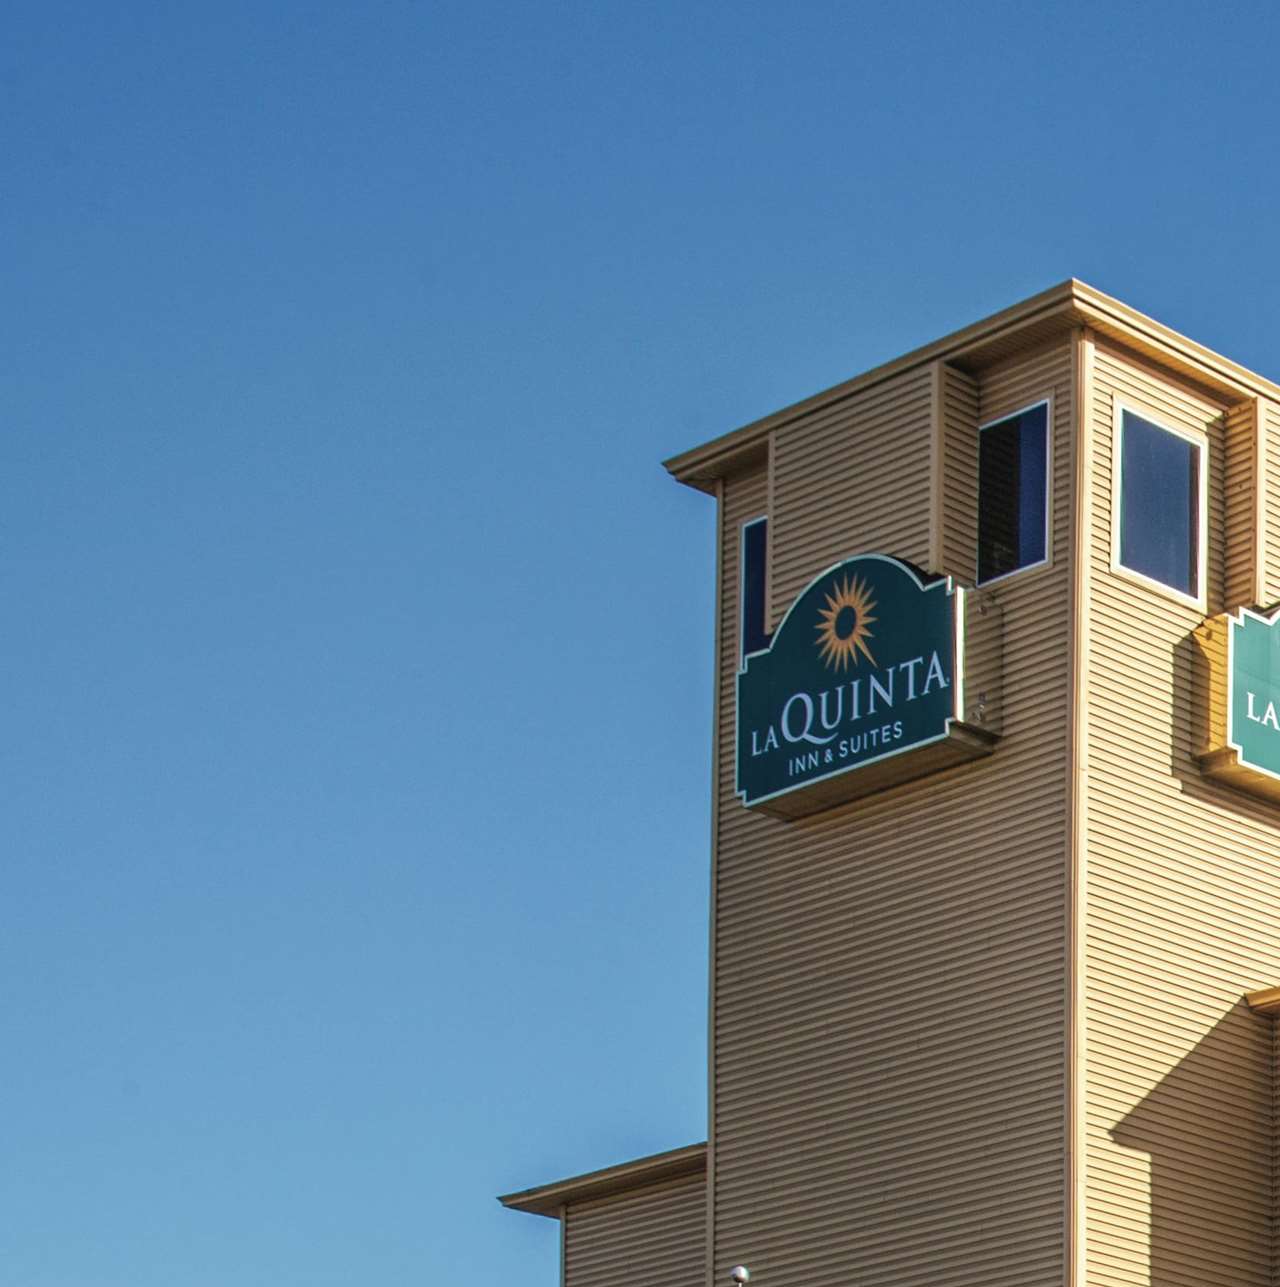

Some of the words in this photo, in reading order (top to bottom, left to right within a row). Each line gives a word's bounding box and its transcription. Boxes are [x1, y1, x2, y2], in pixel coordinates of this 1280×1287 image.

[788, 751, 819, 776] INN
[823, 748, 834, 764] &
[839, 721, 903, 758] SUITES
